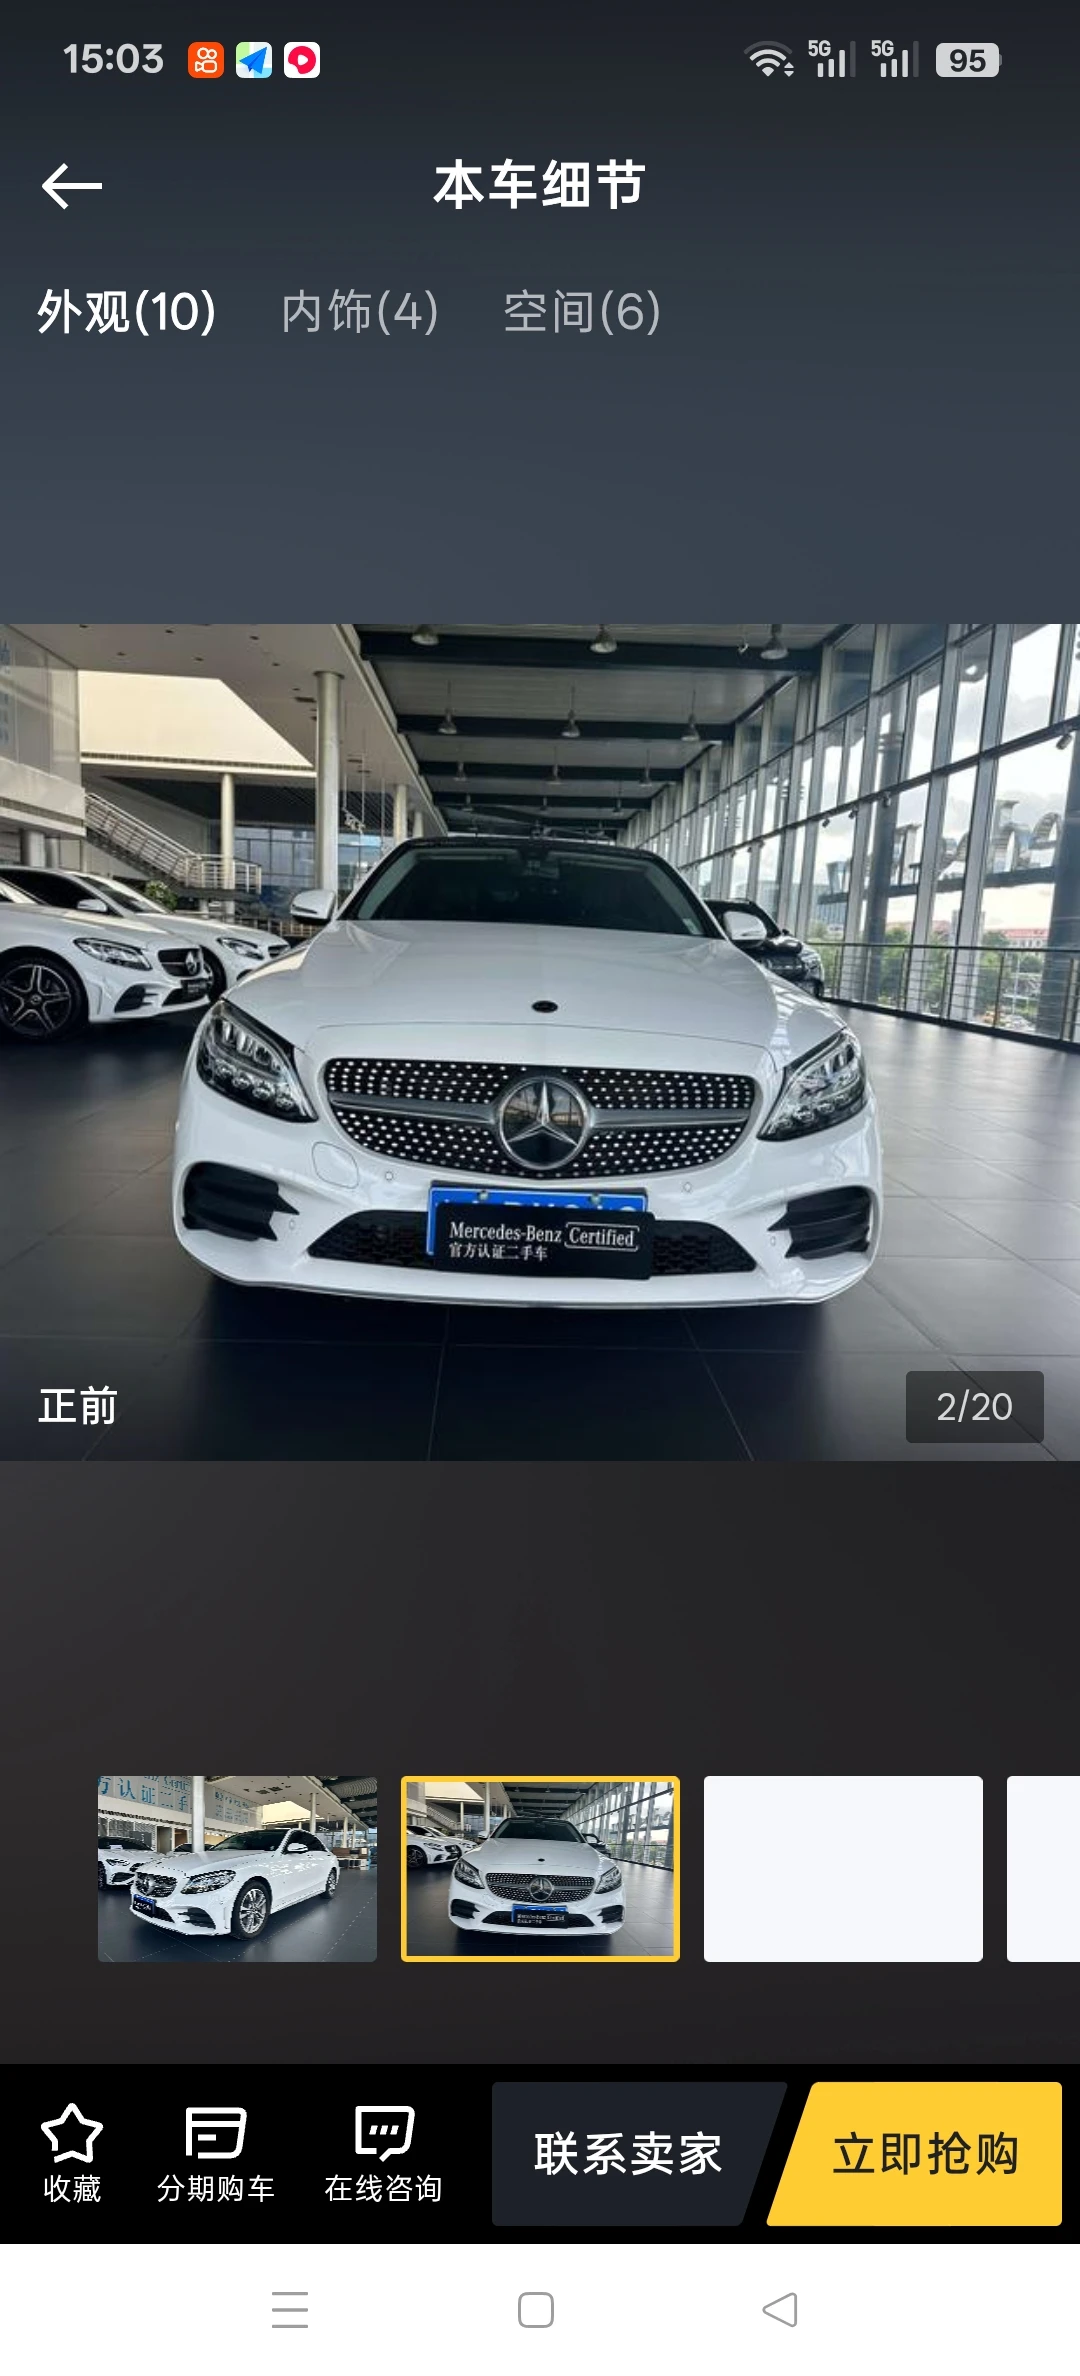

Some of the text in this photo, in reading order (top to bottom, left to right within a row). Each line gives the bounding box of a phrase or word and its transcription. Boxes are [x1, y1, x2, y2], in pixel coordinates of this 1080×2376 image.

[63, 42, 164, 74] 15:03
[807, 39, 832, 57] 5G
[870, 39, 896, 57] 5G
[949, 48, 987, 73] 95
[432, 157, 646, 210] 本车细节
[36, 288, 217, 338] 外观(10)
[281, 288, 439, 338] 内饰(4)
[503, 288, 661, 338] 空间(6)
[449, 1220, 635, 1248] Mercedes-Benz Certified
[448, 1242, 548, 1262] 官方认证二手车
[37, 1384, 118, 1426] 正前
[936, 1388, 1013, 1426] 2/20
[533, 2130, 723, 2177] 联系卖家
[832, 2130, 1018, 2176] 立即抢购
[43, 2173, 102, 2204] 收藏
[156, 2173, 275, 2204] 分期购车
[324, 2173, 442, 2204] 在线咨询
